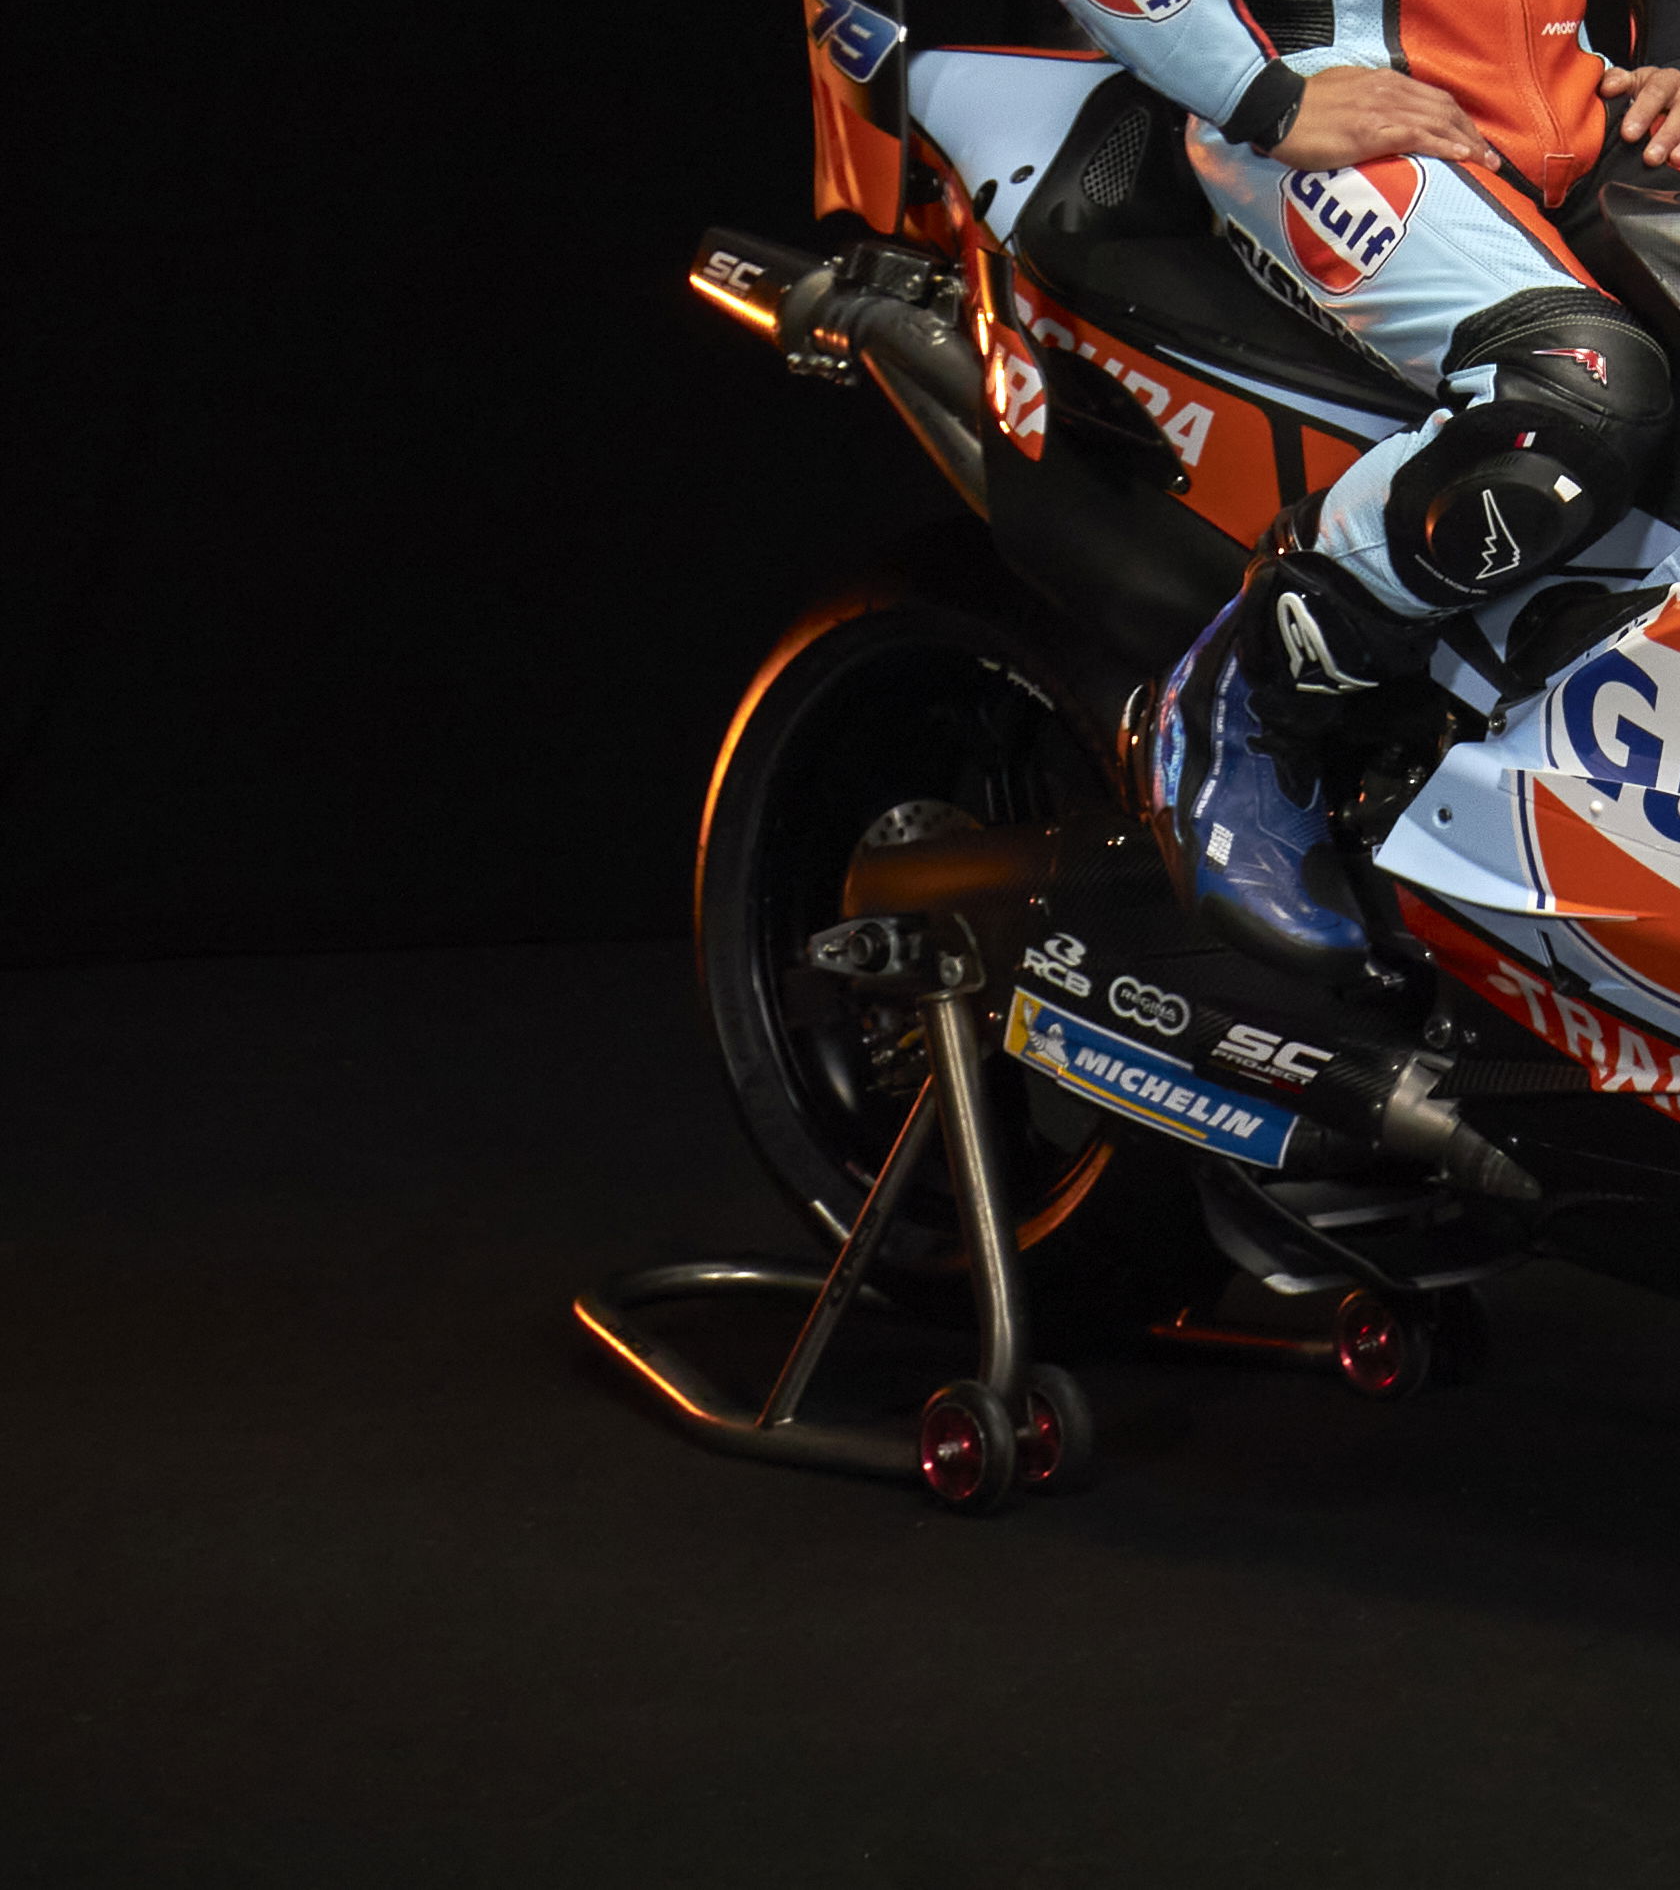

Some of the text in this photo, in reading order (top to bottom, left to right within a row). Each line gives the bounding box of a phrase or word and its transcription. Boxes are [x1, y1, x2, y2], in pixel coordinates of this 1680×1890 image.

[1022, 946, 1092, 998] RCB
[1120, 986, 1177, 1020] REGINA
[1210, 1048, 1314, 1086] PROJECT
[1217, 1023, 1335, 1079] SC
[1074, 1045, 1264, 1139] MICHELIN
